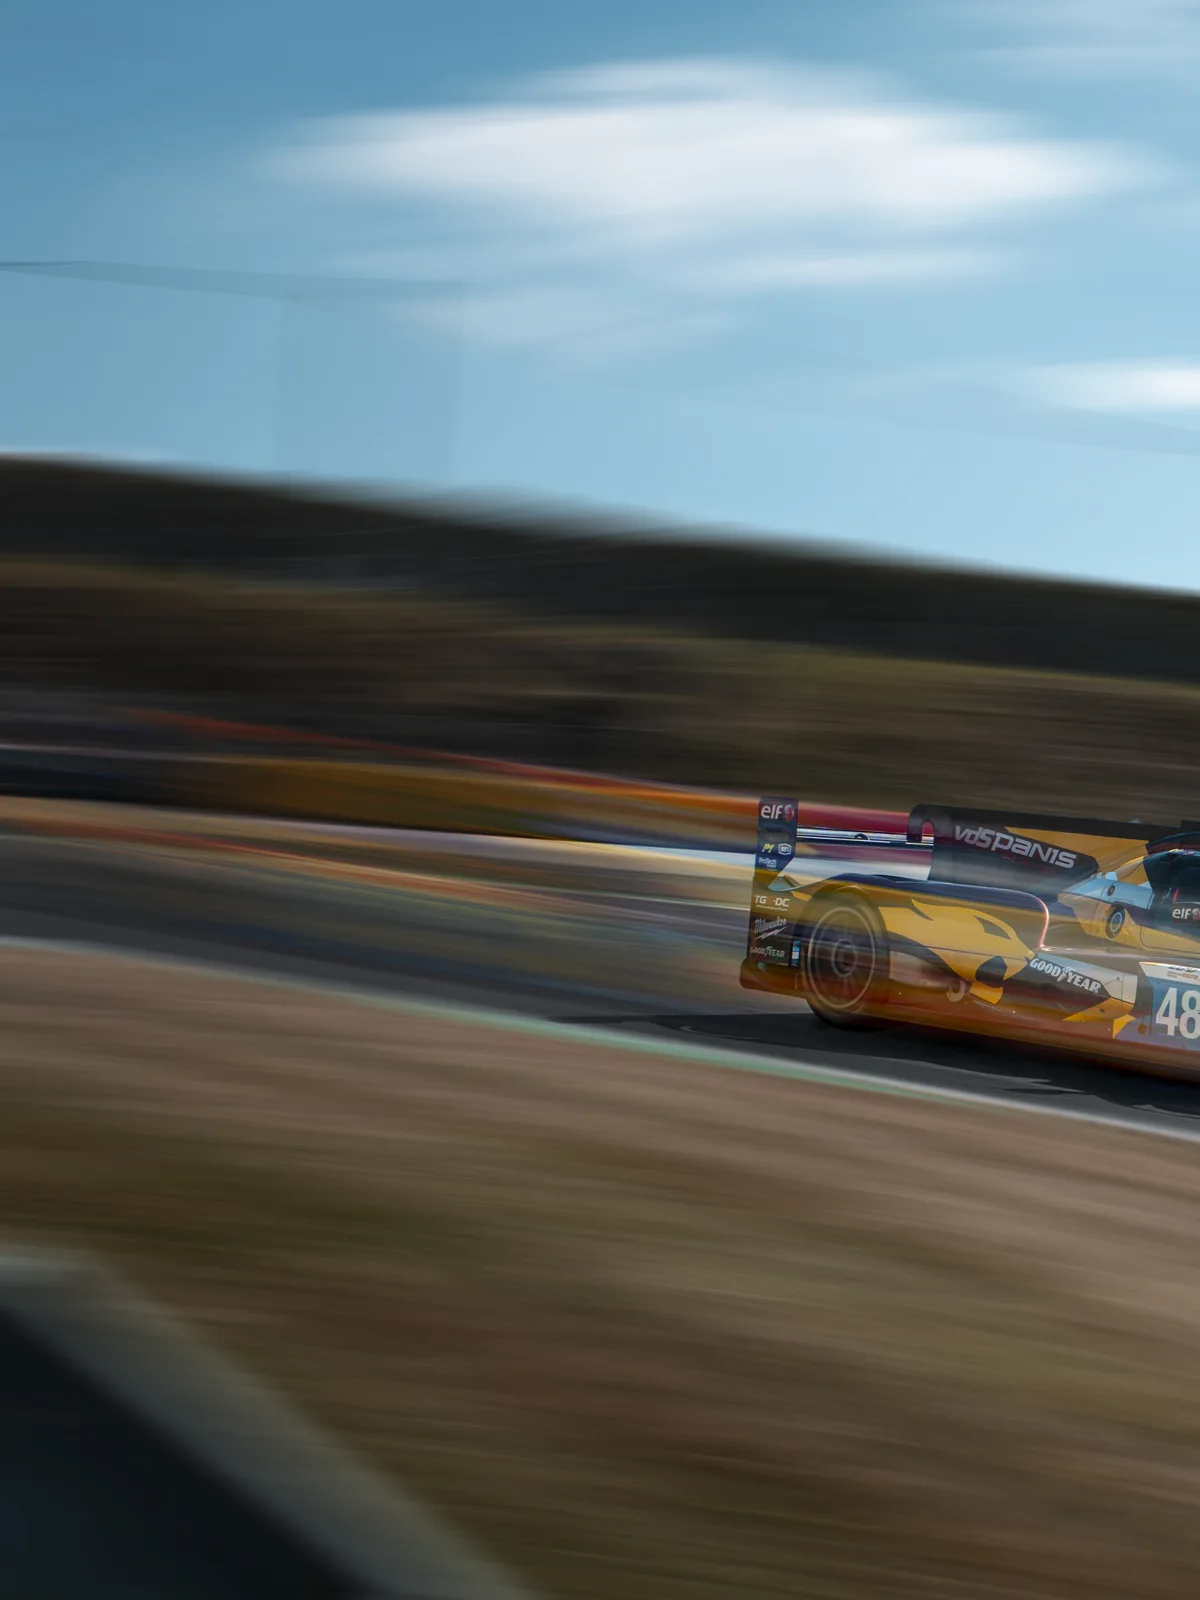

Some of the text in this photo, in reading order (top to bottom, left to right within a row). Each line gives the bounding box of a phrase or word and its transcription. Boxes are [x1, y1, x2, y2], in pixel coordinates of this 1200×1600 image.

[761, 804, 783, 819] elf
[1172, 908, 1191, 919] elf
[750, 946, 785, 957] GOODYEAR
[1030, 958, 1102, 993] GOODYEAR
